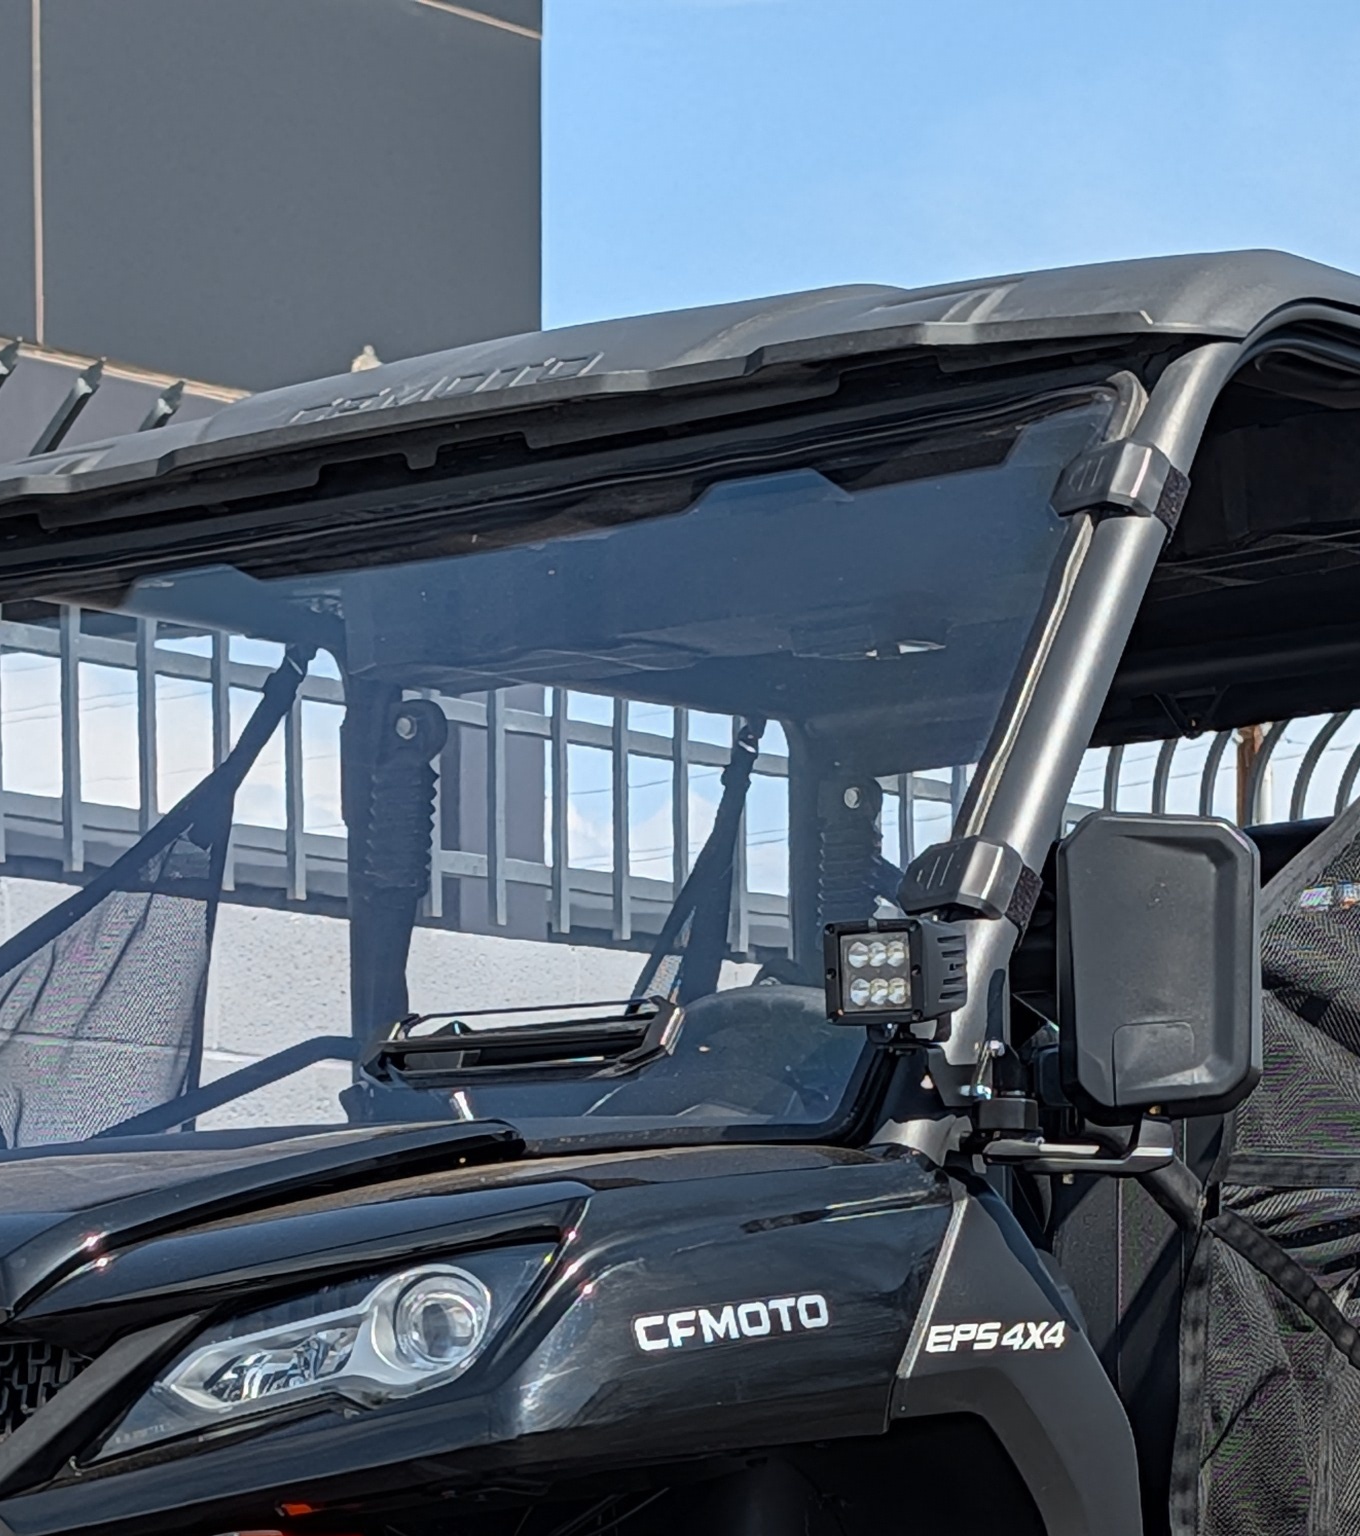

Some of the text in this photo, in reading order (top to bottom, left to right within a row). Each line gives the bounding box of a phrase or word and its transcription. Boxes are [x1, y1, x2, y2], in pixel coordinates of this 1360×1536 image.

[634, 1294, 829, 1351] CFMOTO
[925, 1320, 1066, 1353] EPS 4X4
